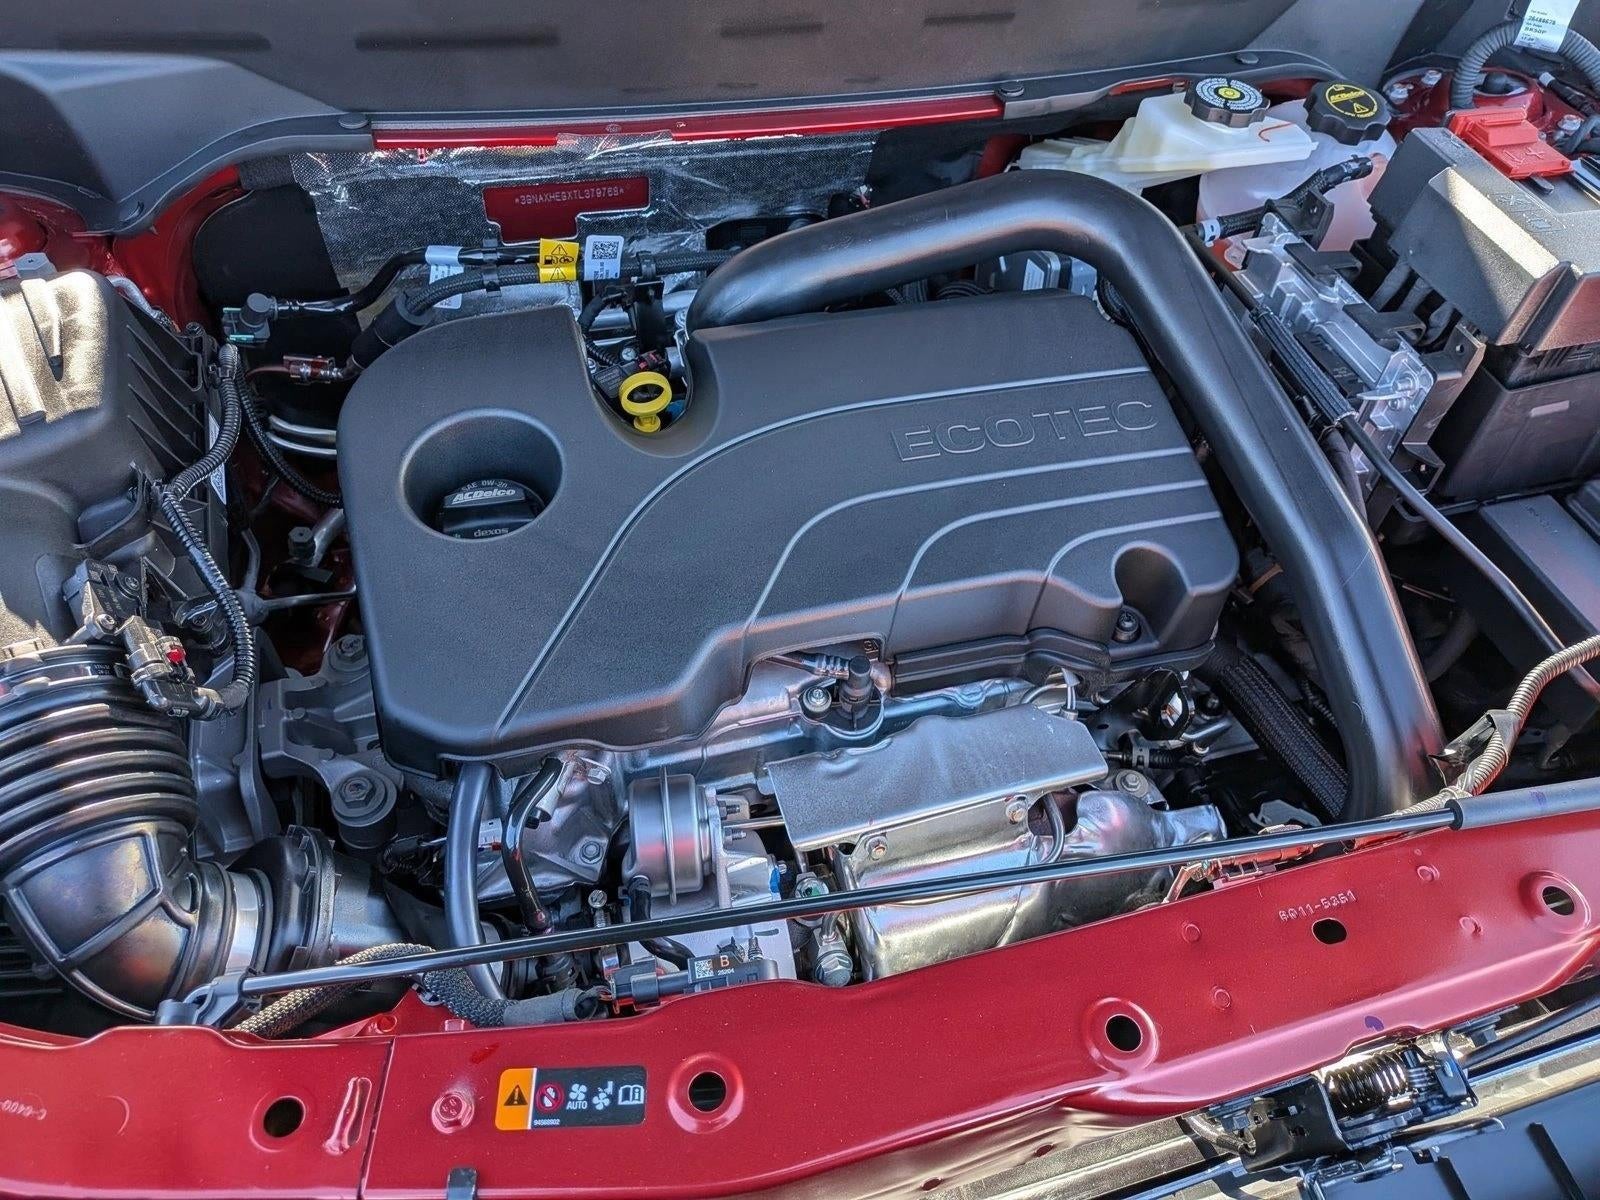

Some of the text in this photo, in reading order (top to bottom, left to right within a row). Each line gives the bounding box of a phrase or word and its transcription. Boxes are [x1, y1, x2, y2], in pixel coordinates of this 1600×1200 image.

[891, 400, 1159, 462] ECOTEC
[461, 481, 478, 493] SAE
[451, 488, 516, 505] ACDelco
[473, 527, 509, 538] dexos
[720, 955, 730, 967] B
[566, 1101, 588, 1111] AUTO
